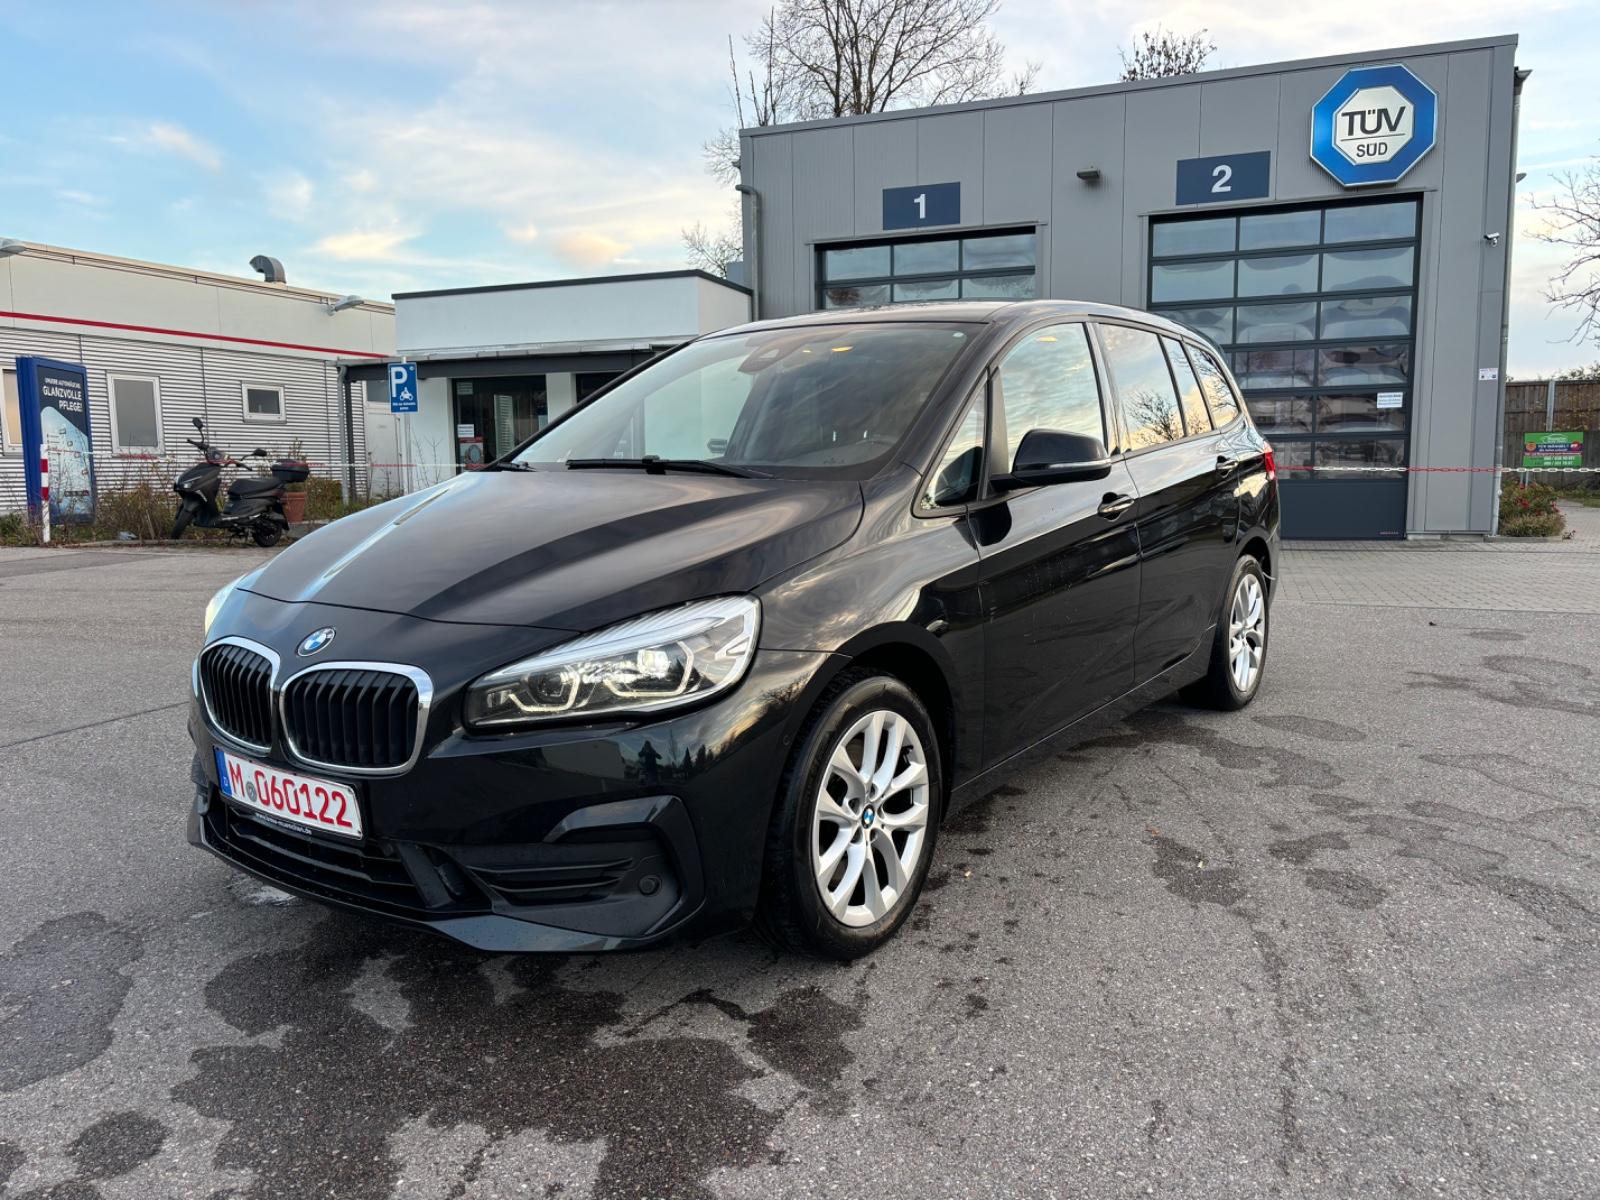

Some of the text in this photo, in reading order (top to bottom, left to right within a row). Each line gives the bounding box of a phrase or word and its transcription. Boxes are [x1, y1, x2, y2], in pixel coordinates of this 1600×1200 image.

[1341, 106, 1406, 136] TÜV
[1356, 142, 1388, 157] SÜD
[1211, 164, 1232, 193] 2
[913, 193, 926, 219] 1
[43, 386, 82, 401] GLANZVOLLE
[390, 366, 408, 398] P
[58, 400, 83, 412] PFLEGE!
[228, 760, 245, 797] M
[254, 769, 352, 828] 060122
